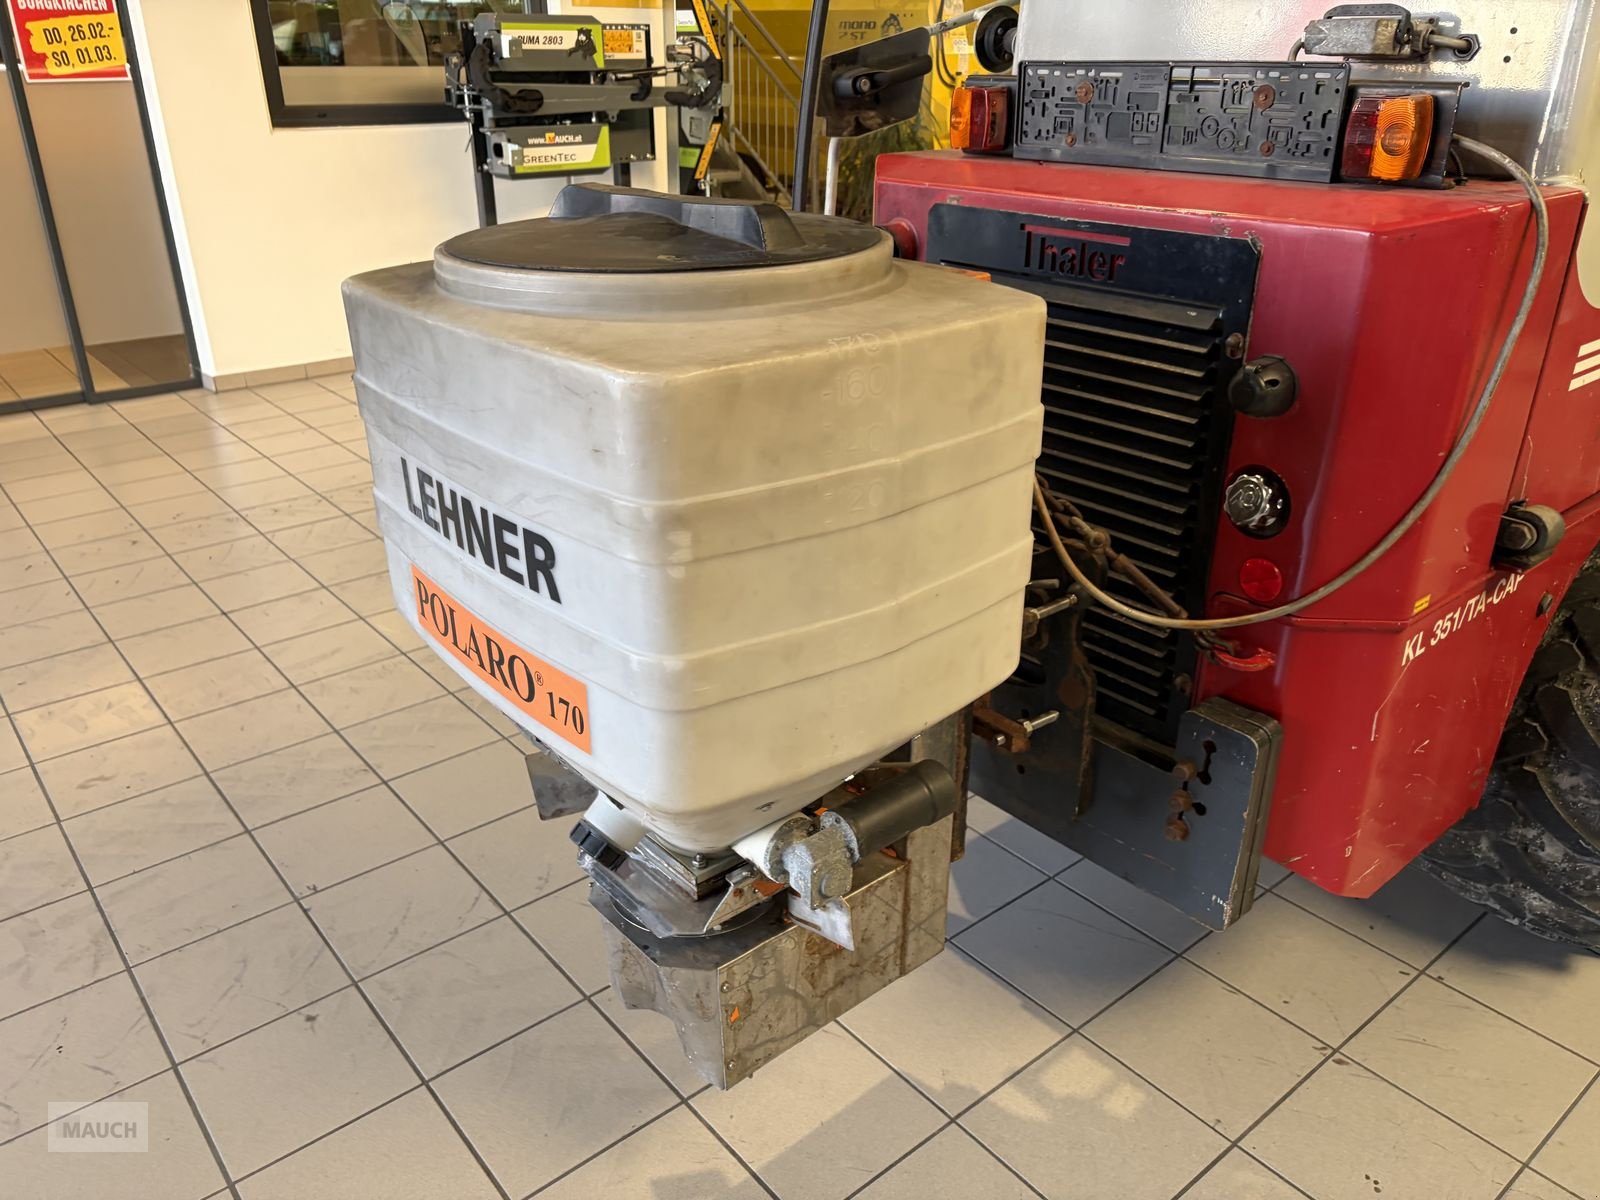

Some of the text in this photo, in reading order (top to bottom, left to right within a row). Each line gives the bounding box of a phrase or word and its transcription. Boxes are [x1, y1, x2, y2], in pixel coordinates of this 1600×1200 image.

[43, 22, 114, 46] DO, 26.02.-
[542, 35, 564, 45] 2803
[51, 45, 117, 68] SO, 01.03.
[1020, 223, 1131, 282] Thaler
[400, 456, 562, 605] LEHNER
[1401, 631, 1426, 666] KL
[547, 691, 585, 735] 170
